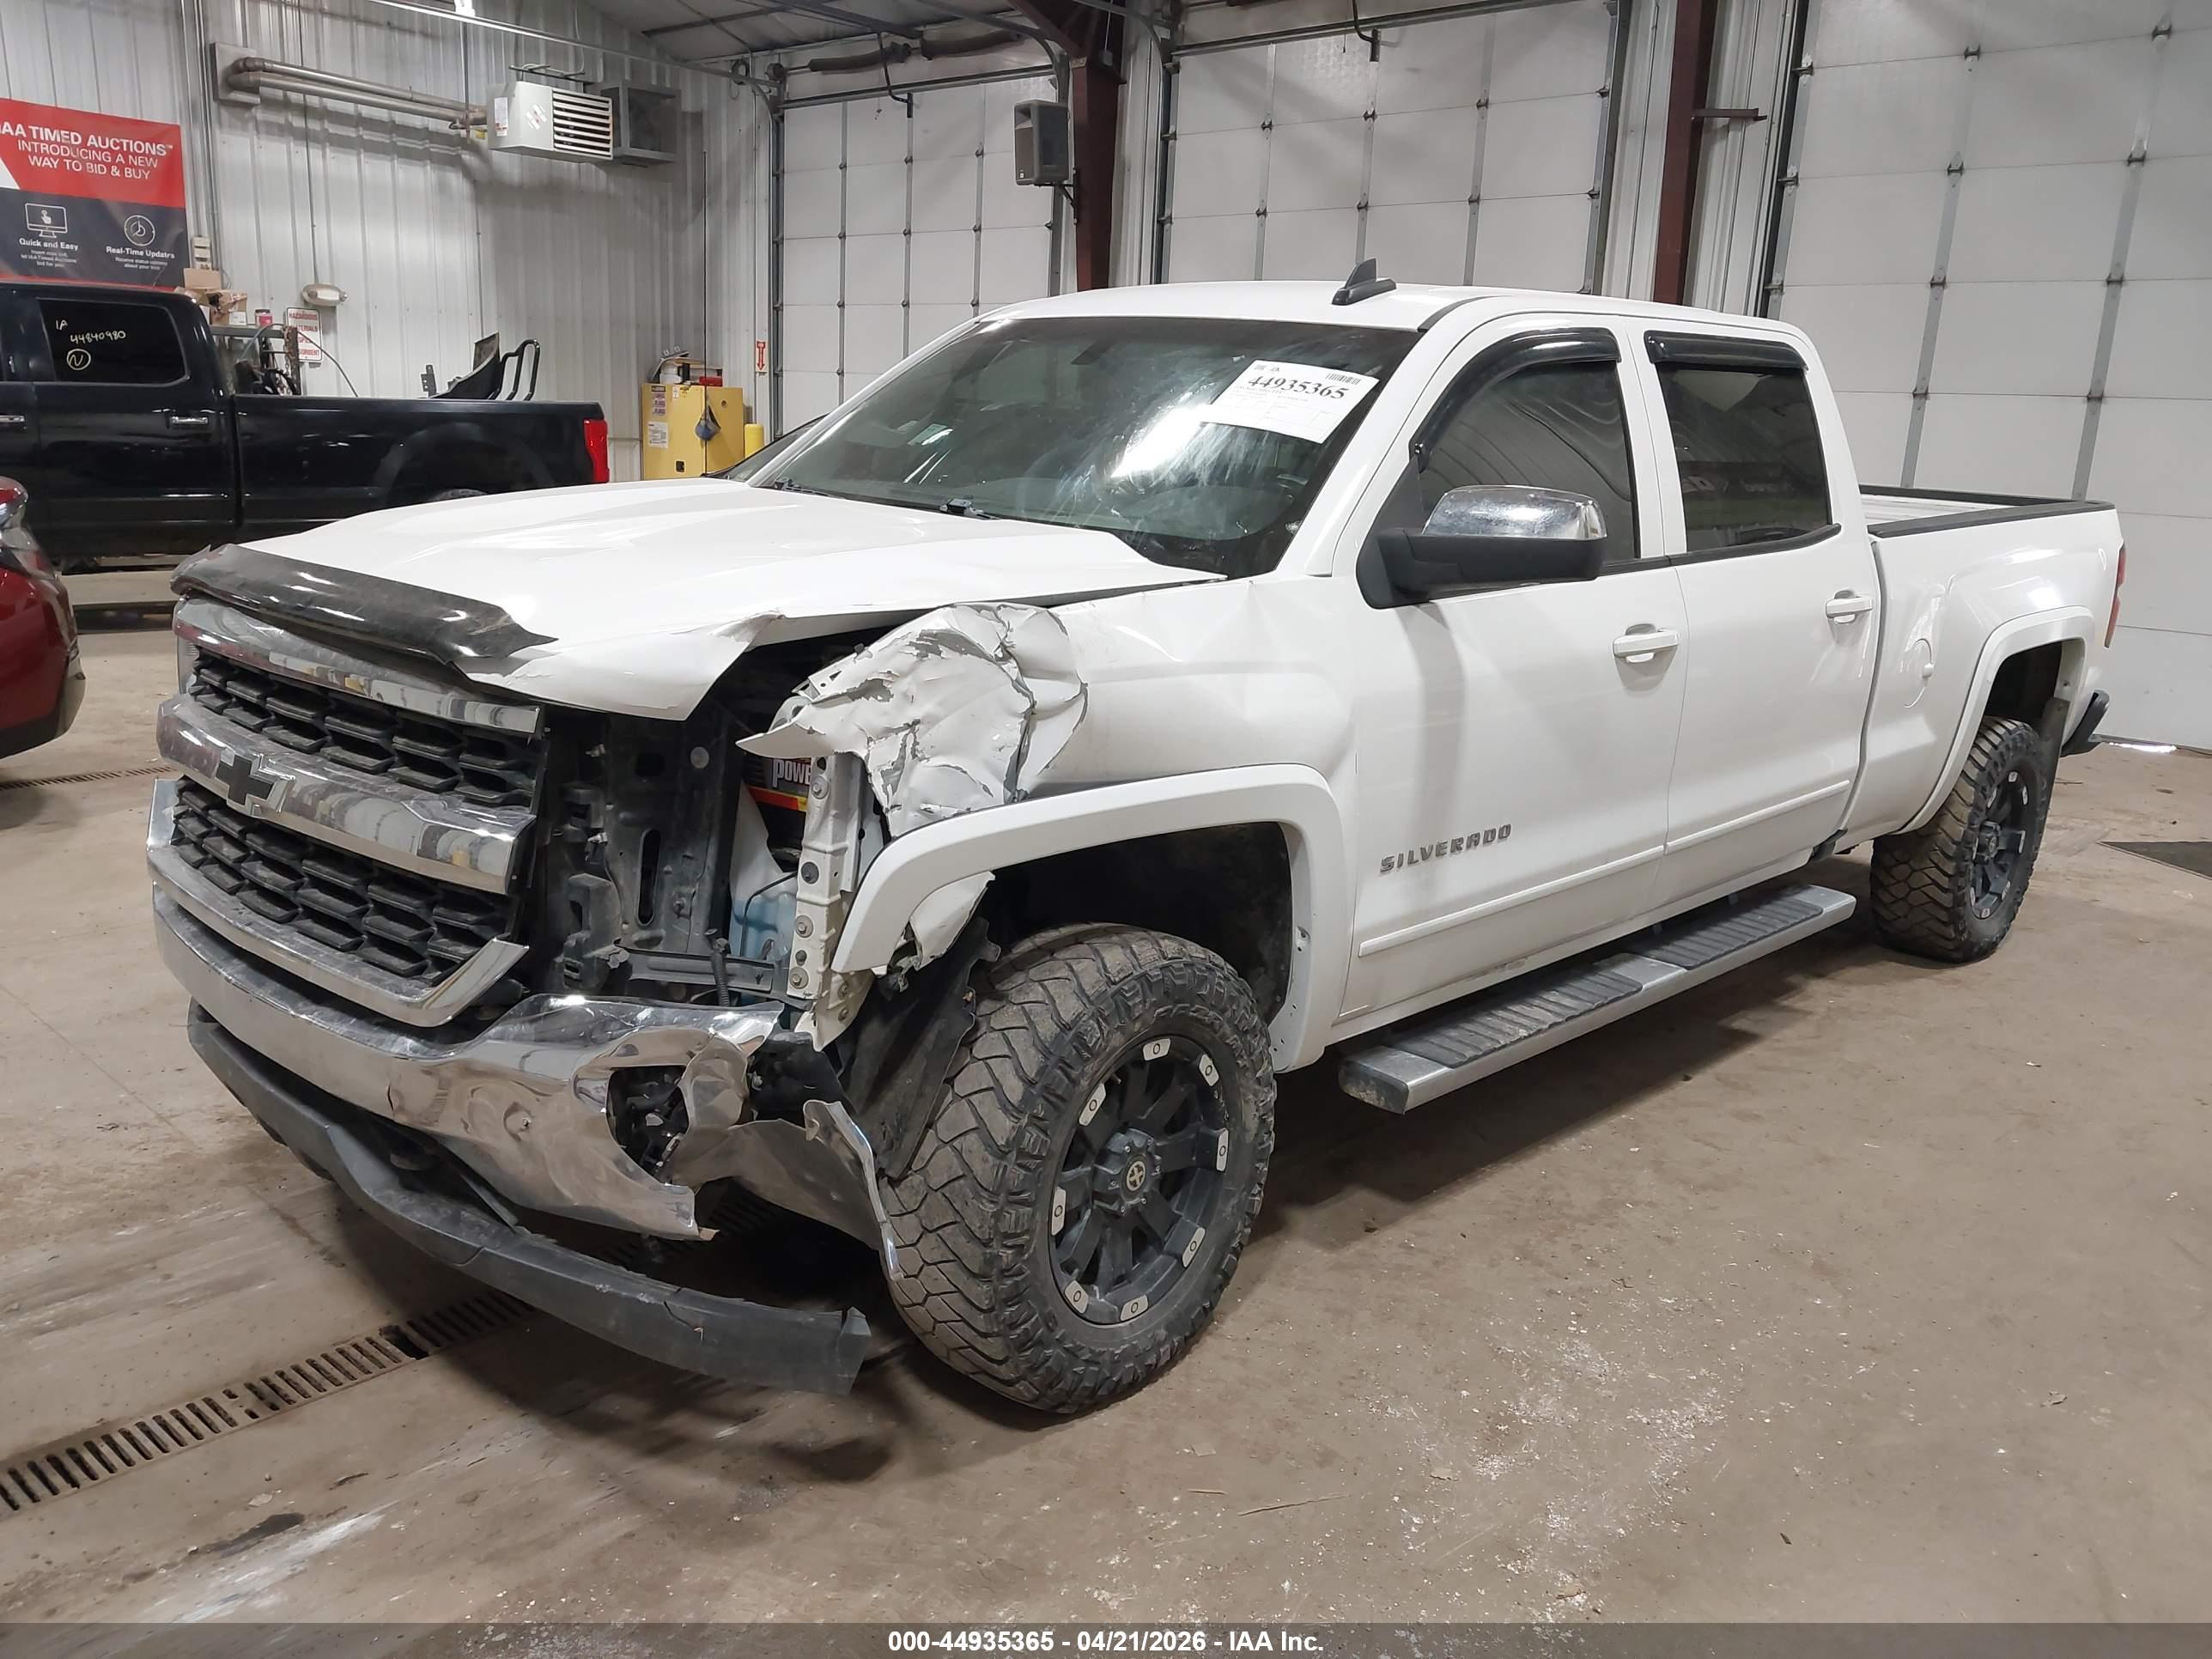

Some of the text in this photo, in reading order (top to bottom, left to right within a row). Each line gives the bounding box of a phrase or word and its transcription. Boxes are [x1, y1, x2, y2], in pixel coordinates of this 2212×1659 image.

[28, 125, 82, 145] TIMED
[18, 139, 158, 168] INTRODUCING A NEW
[28, 155, 150, 179] WAY TO BID & BUY
[19, 237, 78, 252] Quick and Easy
[106, 246, 144, 256] Real-Time
[70, 331, 126, 344] 44840980
[1248, 375, 1349, 399] 44935365
[772, 759, 811, 787] POWE
[1379, 823, 1511, 873] SILVERADO
